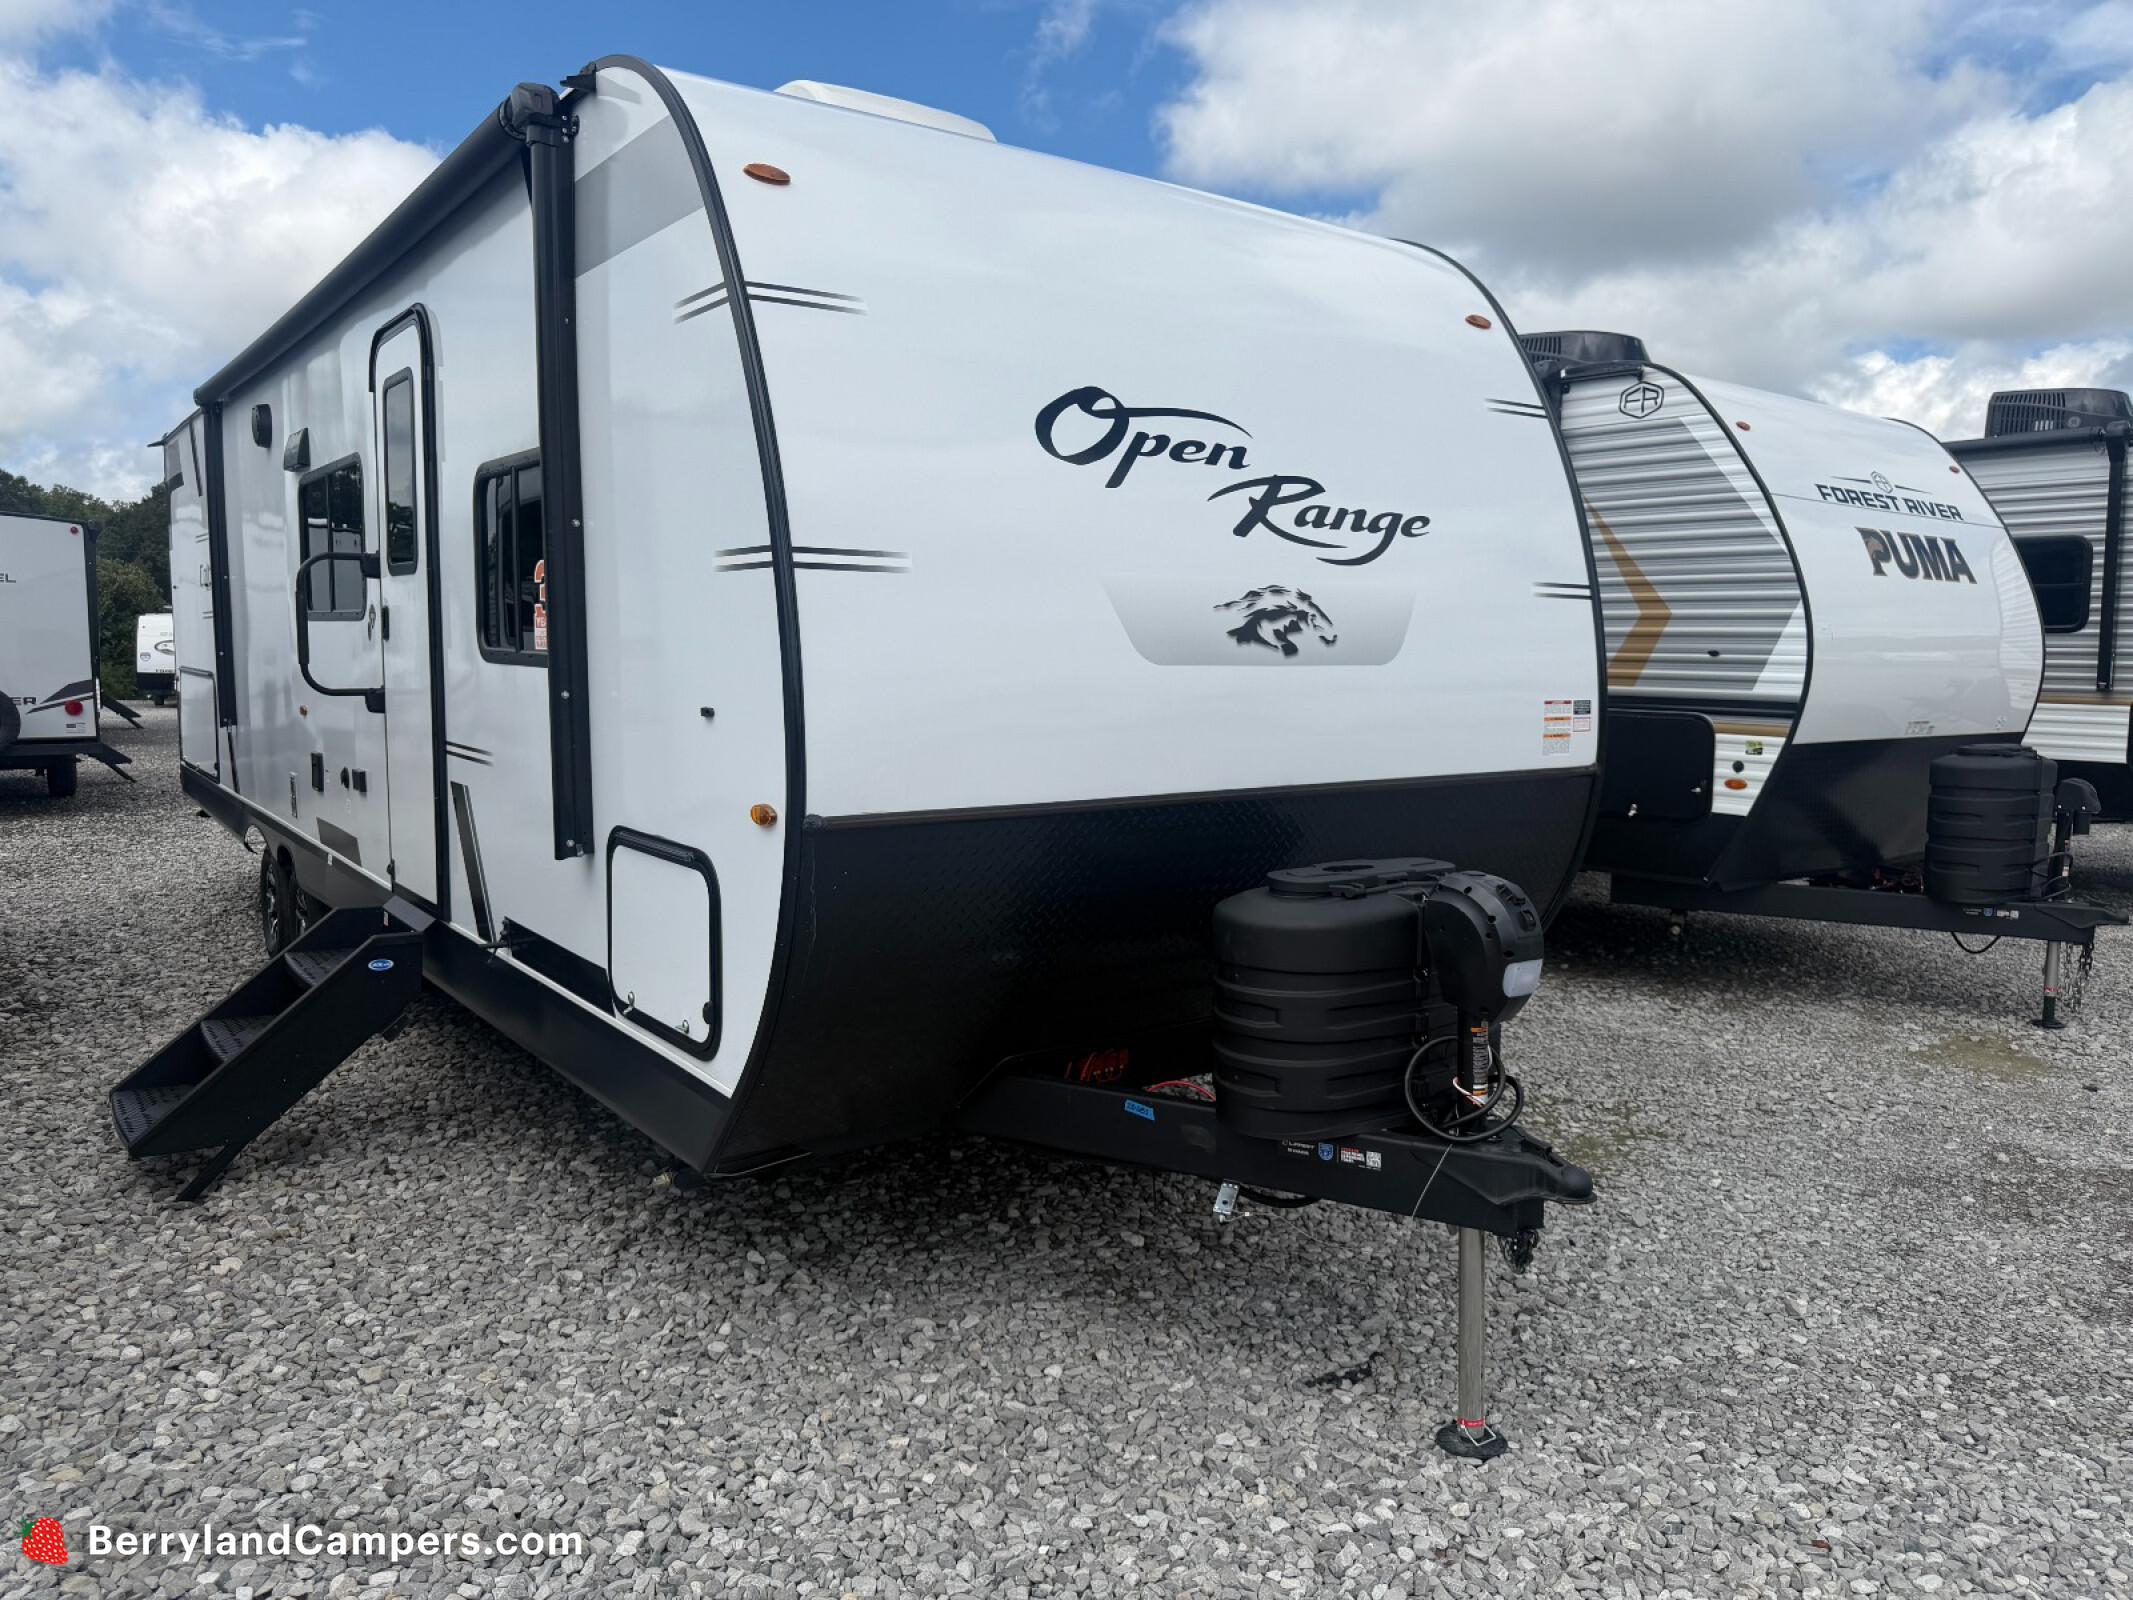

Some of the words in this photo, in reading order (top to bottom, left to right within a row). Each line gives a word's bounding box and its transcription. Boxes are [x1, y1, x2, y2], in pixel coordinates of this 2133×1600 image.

[1035, 386, 1253, 488] Open
[1207, 475, 1430, 566] Range
[1814, 484, 1900, 512] FOREST
[1901, 497, 1964, 520] RIVER
[1854, 527, 1977, 584] PUMA
